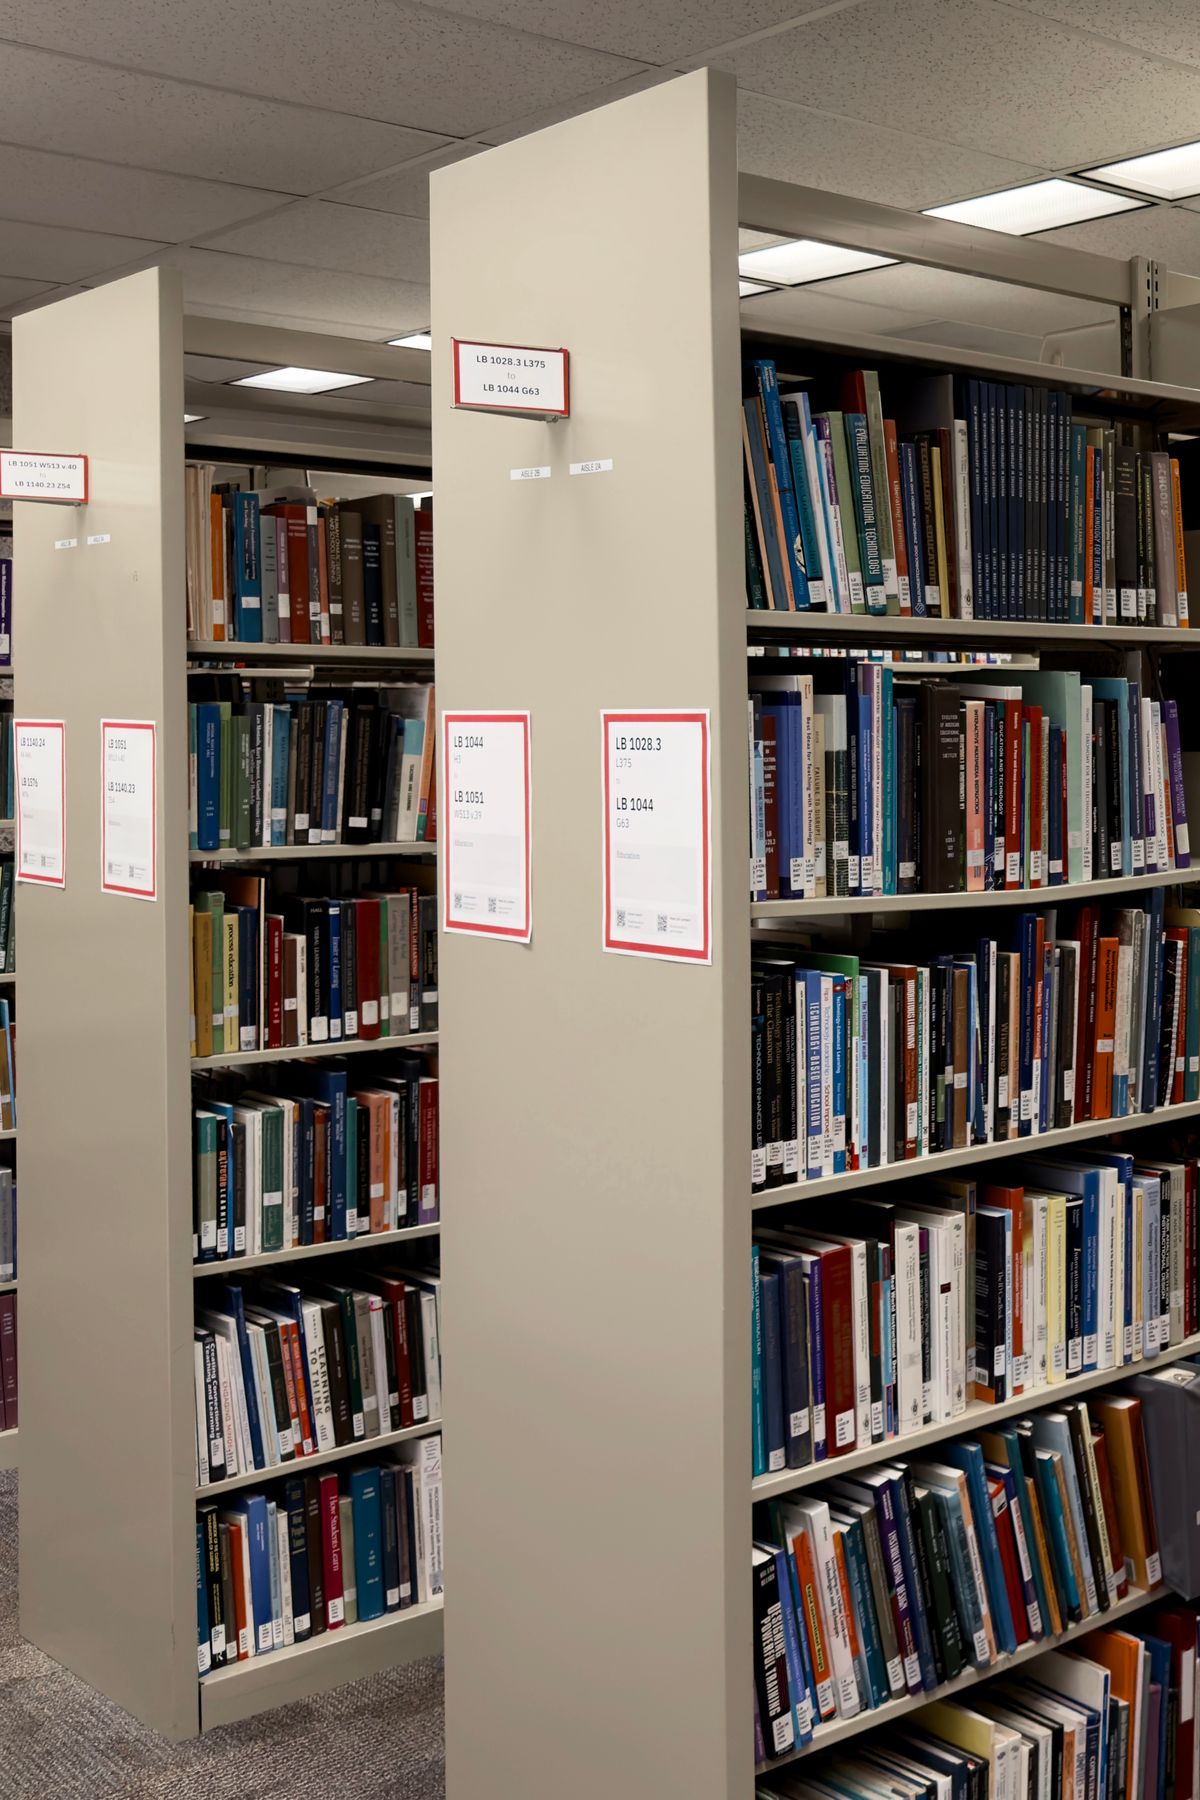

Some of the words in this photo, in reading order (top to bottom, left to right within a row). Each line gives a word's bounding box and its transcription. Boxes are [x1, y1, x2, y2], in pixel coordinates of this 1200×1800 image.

[476, 355, 488, 364] LB
[490, 356, 521, 366] 1028.3
[523, 359, 546, 369] L375
[507, 372, 516, 380] to
[483, 383, 495, 392] LB
[497, 385, 519, 394] 1044
[521, 387, 540, 396] G63
[855, 429, 868, 473] EVALUATING
[859, 475, 872, 524] EDUCATIONAL
[893, 480, 904, 518] Liberating
[865, 528, 881, 574] TECHNOLOGY
[454, 735, 463, 748] LB
[465, 736, 484, 748] 1044
[616, 737, 627, 750] LB
[629, 737, 662, 751] 1028.3
[616, 758, 632, 768] L375
[454, 790, 464, 803] LB
[465, 791, 484, 804] 1051
[616, 797, 627, 811] LB
[630, 798, 654, 812] 1044
[616, 818, 630, 829] G63
[227, 924, 235, 952] process
[228, 953, 236, 987] education
[1024, 986, 1032, 1015] Planning
[809, 1002, 821, 1081] TECHNOLOGY-BASED
[1000, 1022, 1009, 1051] What
[1000, 1053, 1008, 1073] Nex
[810, 1084, 821, 1126] EDUCATION
[205, 1345, 213, 1383] Teaching
[210, 1343, 218, 1379] Creating
[309, 1350, 318, 1365] TO
[311, 1371, 322, 1416] THINK
[318, 1345, 330, 1414] LEARNING
[212, 1380, 221, 1429] Connections
[329, 1496, 338, 1515] How
[330, 1516, 339, 1548] Students
[332, 1548, 340, 1571] Learn
[888, 1530, 905, 1583] INSTRUCTIONAL
[896, 1583, 908, 1611] DESIGN
[760, 1617, 778, 1666] POWERFUL
[767, 1601, 785, 1658] DESIGNING
[764, 1667, 781, 1716] TRAINING
